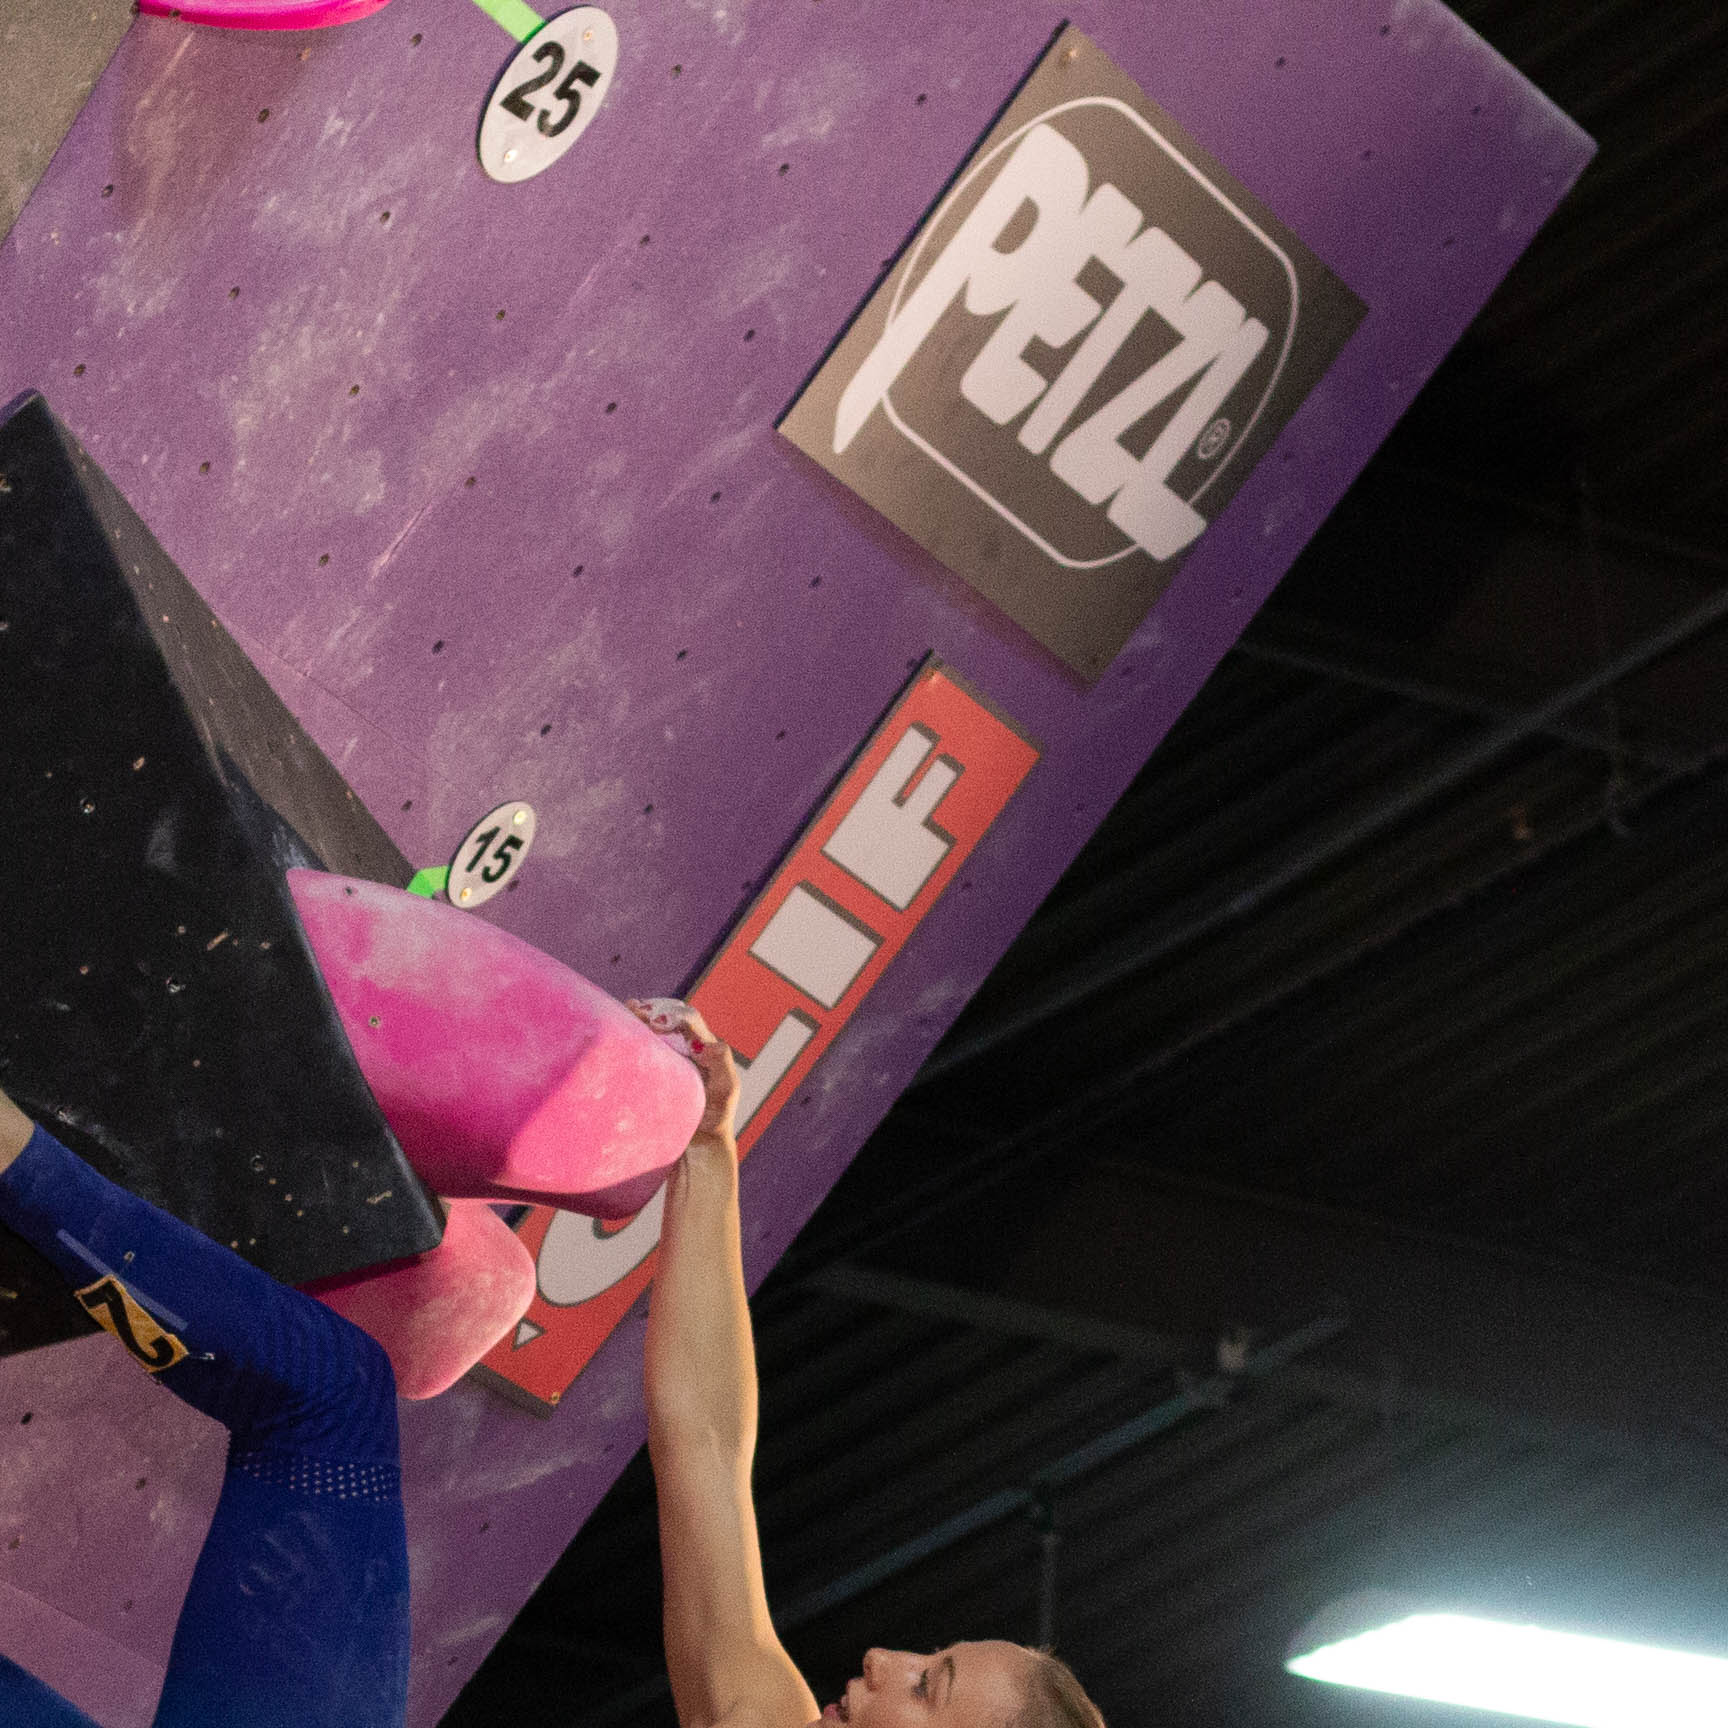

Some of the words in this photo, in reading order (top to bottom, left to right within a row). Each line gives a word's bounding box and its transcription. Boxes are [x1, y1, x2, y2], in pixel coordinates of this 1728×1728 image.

[499, 40, 602, 138] 25
[833, 122, 1270, 561] PETZL
[465, 826, 525, 883] 15
